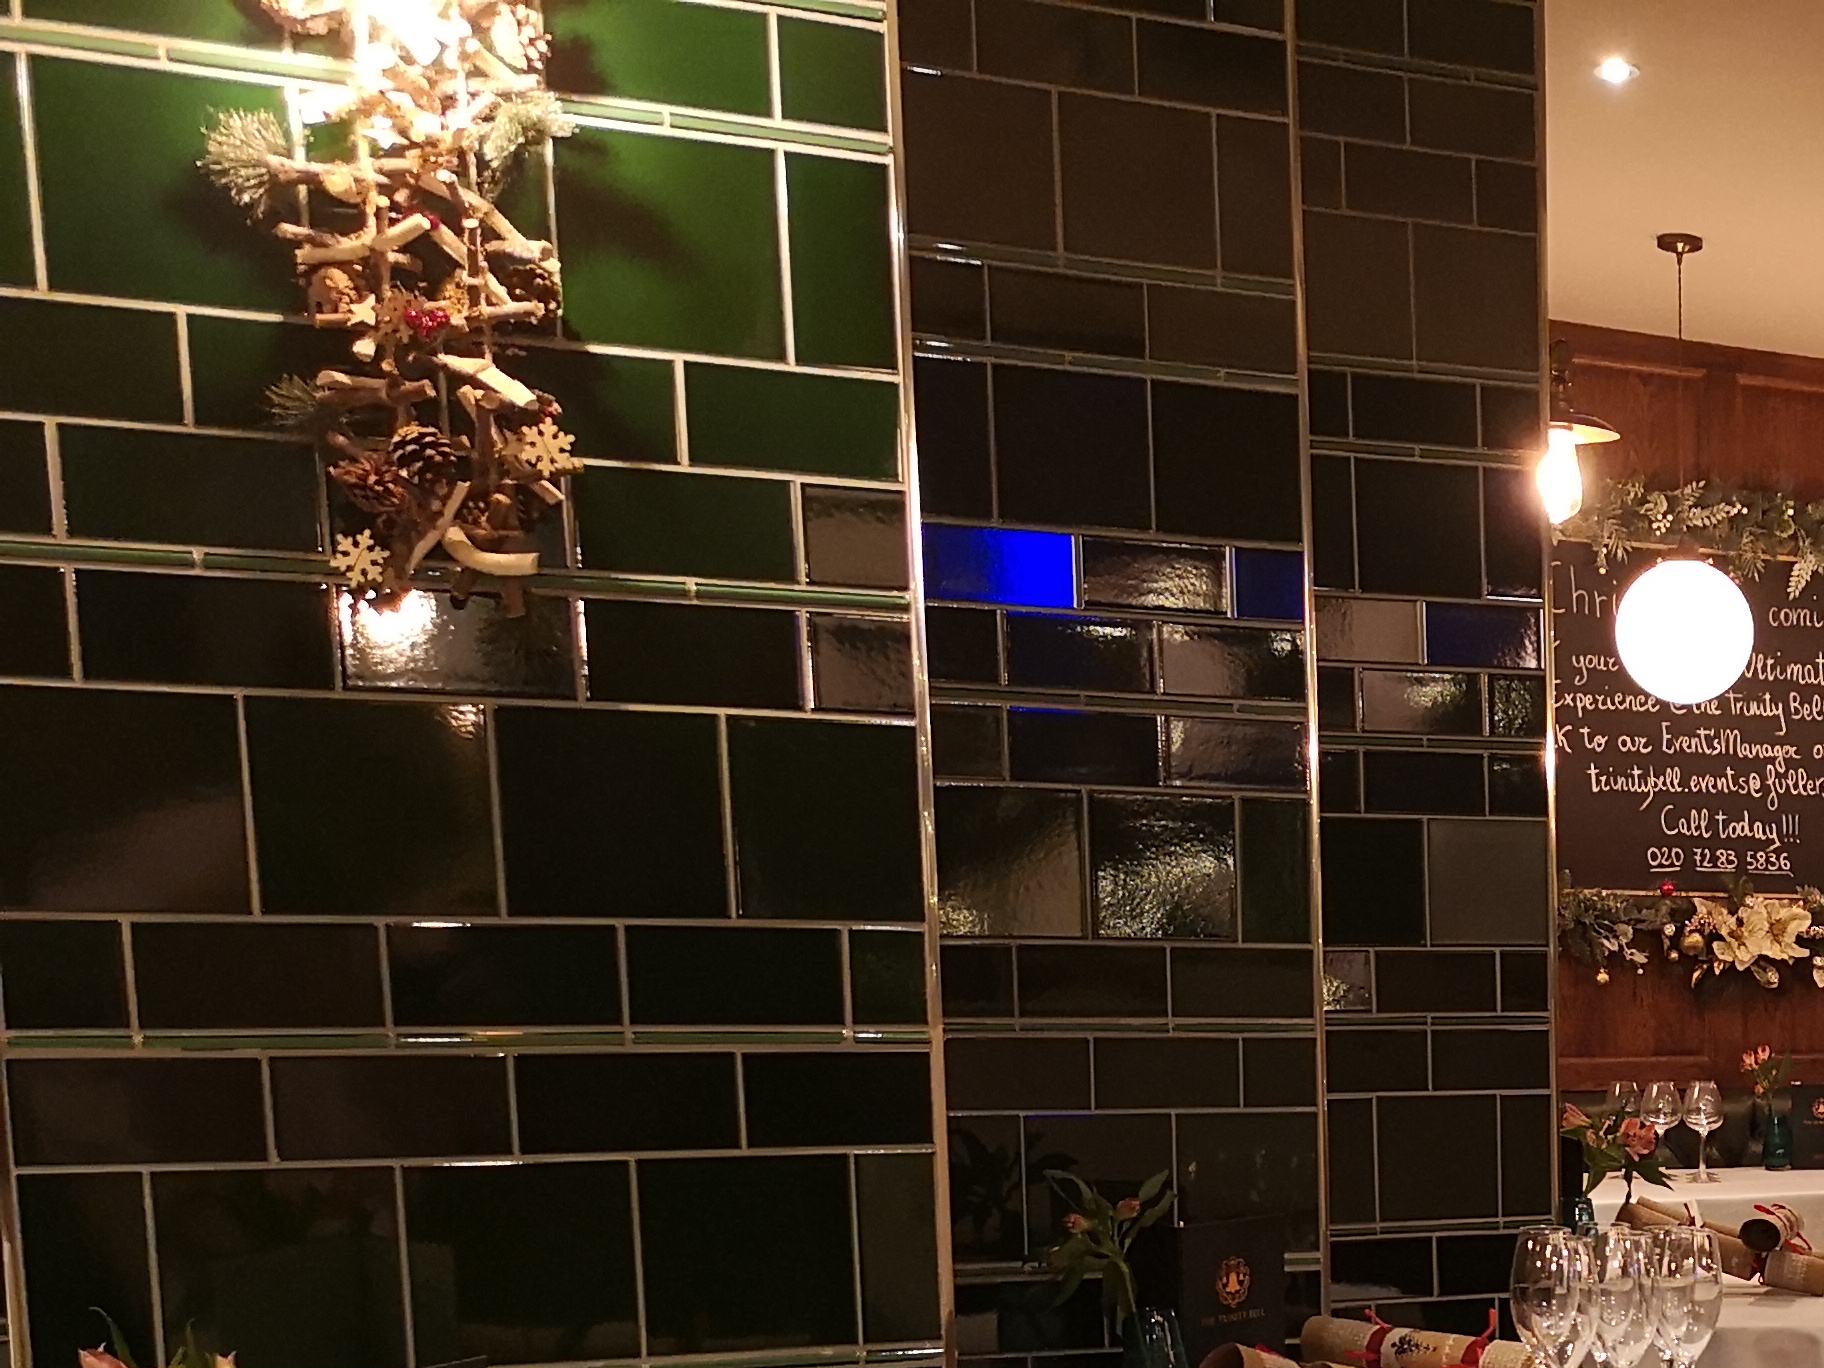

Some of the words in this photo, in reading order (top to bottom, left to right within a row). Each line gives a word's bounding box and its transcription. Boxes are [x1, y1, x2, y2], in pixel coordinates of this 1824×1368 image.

[1572, 653, 1619, 685] your
[1579, 726, 1608, 753] to
[1661, 804, 1712, 839] Call
[1647, 846, 1684, 866] 020
